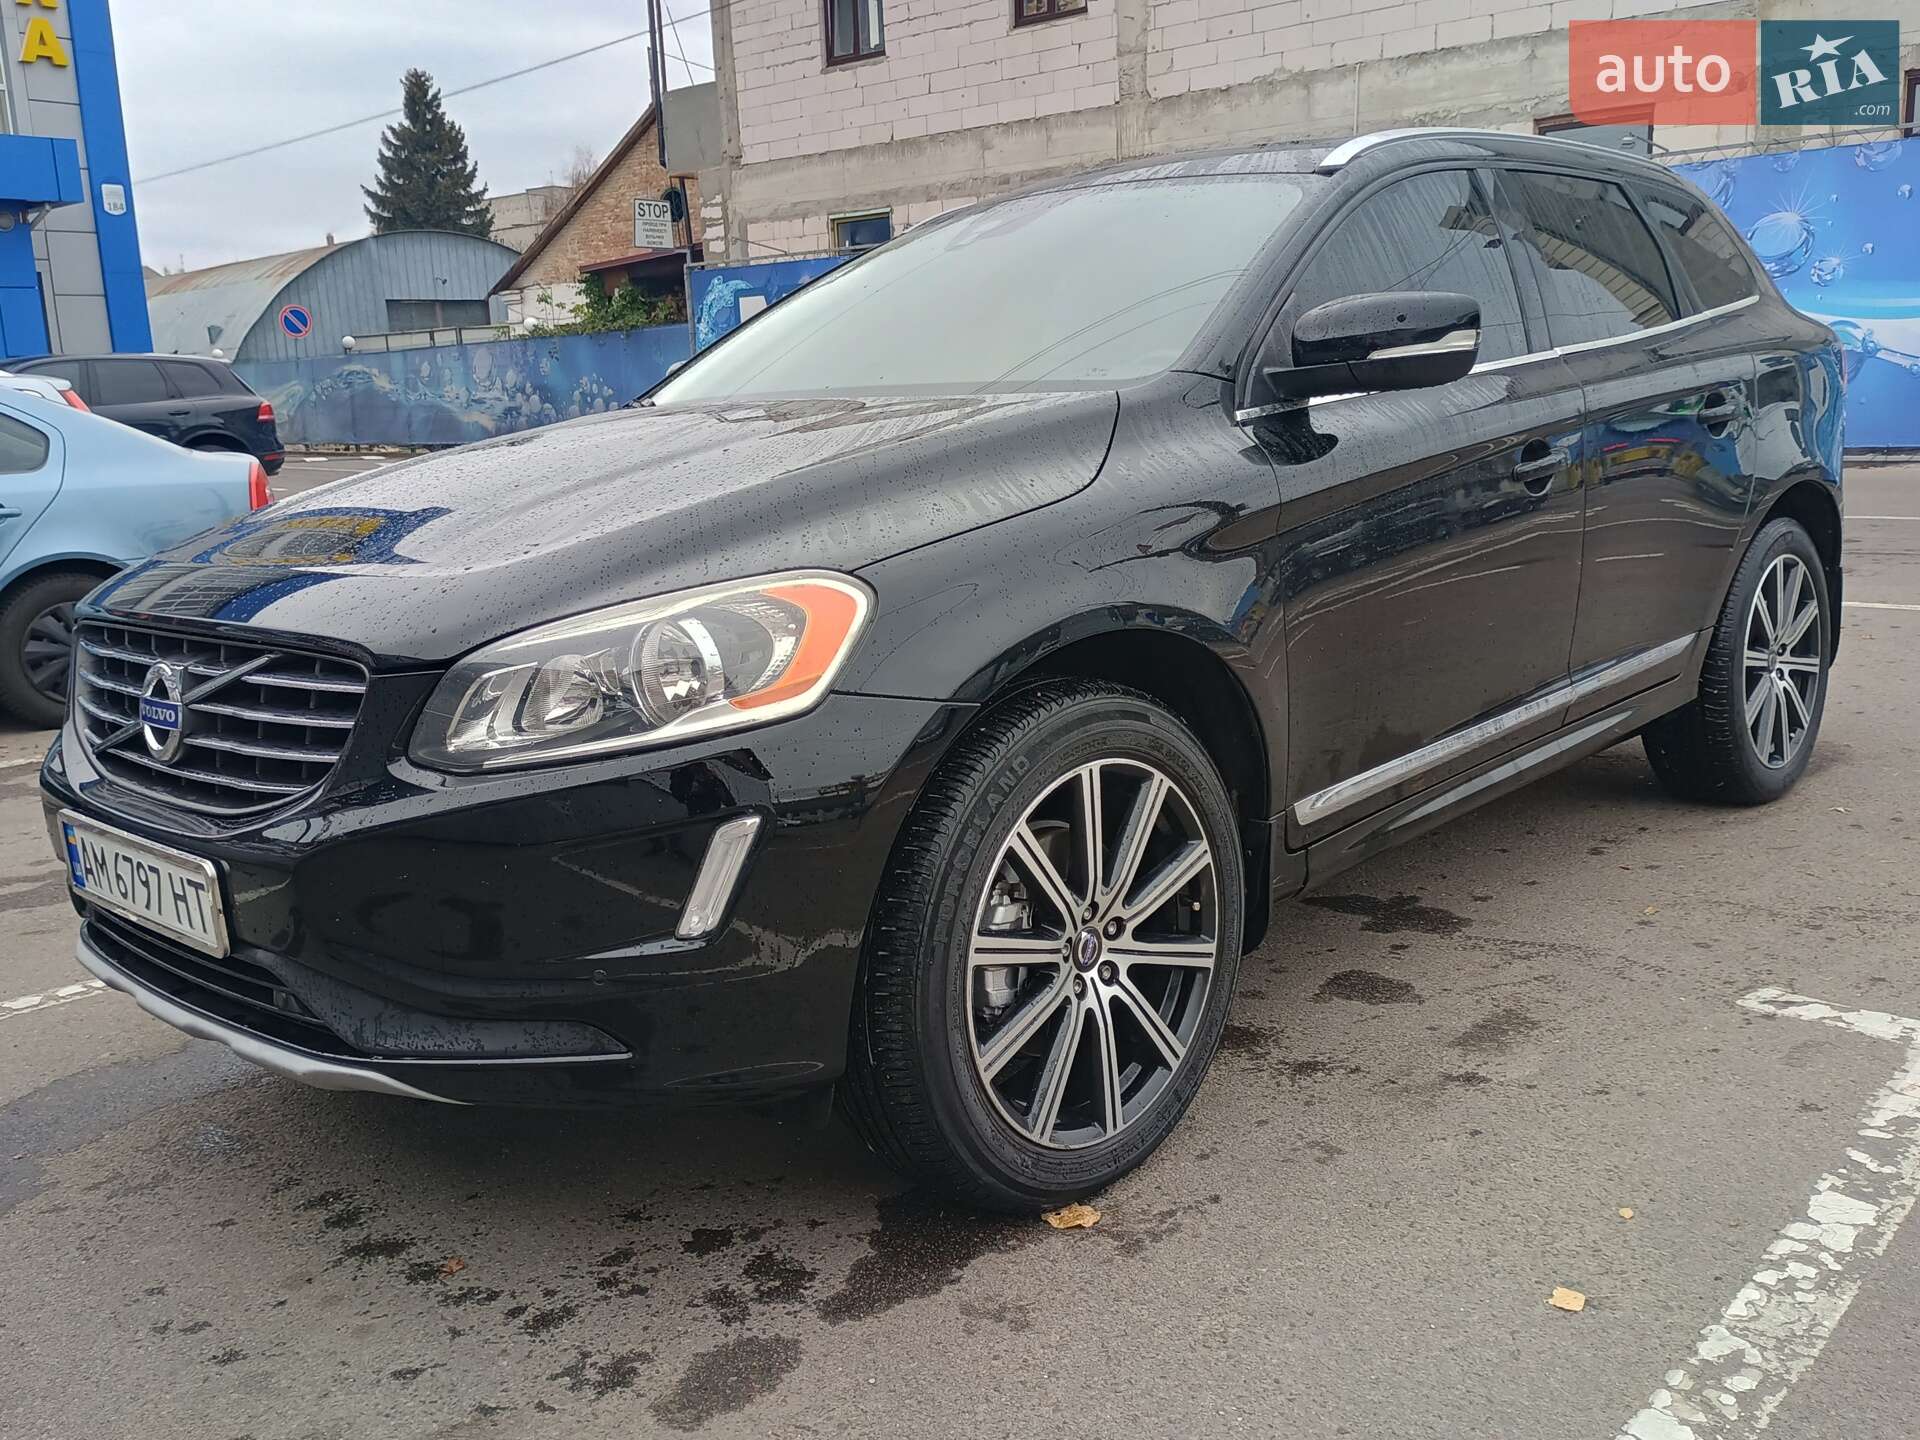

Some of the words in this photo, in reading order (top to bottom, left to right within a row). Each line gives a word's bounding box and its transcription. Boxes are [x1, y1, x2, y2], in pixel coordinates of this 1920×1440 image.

[16, 0, 69, 68] А
[637, 203, 669, 219] STOP
[142, 703, 176, 722] VOLVO
[80, 836, 114, 895] AM
[114, 851, 162, 916] 6797
[168, 872, 208, 934] HT
